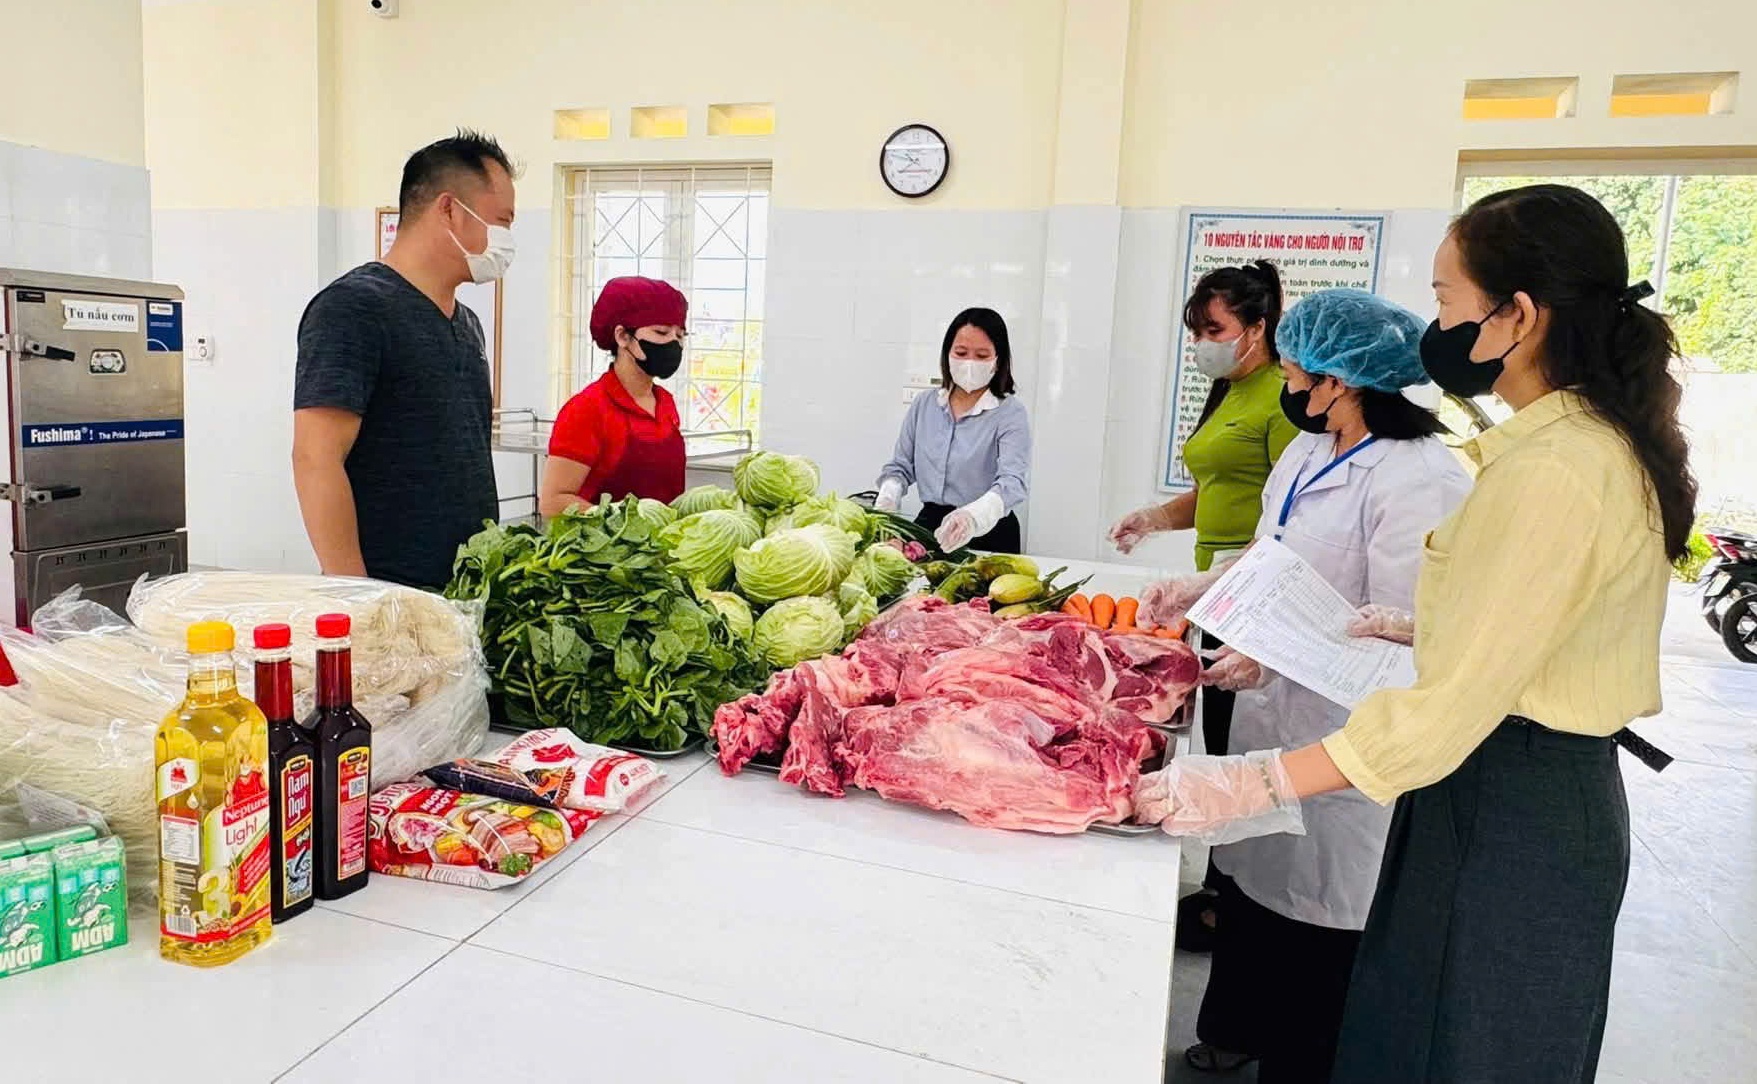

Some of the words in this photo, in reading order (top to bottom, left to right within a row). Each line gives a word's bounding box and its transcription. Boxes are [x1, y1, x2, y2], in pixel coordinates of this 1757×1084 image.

[1204, 233, 1213, 247] 10
[1215, 231, 1245, 248] NGUYÊN
[1247, 230, 1262, 248] TẮC
[1264, 231, 1285, 249] VÀNG
[1287, 235, 1304, 249] CHO
[1305, 233, 1329, 250] NGƯỜI
[1332, 233, 1346, 254] NỘI
[1350, 235, 1365, 255] TRỢ
[87, 306, 109, 320] nấu
[111, 313, 134, 322] cơm
[99, 432, 111, 440] The
[112, 430, 129, 439] Pride
[130, 430, 137, 438] of
[288, 772, 309, 797] Nam
[420, 789, 444, 811] NGON
[226, 815, 257, 846] Light
[71, 921, 116, 951] ADM
[0, 942, 44, 971] ADM
